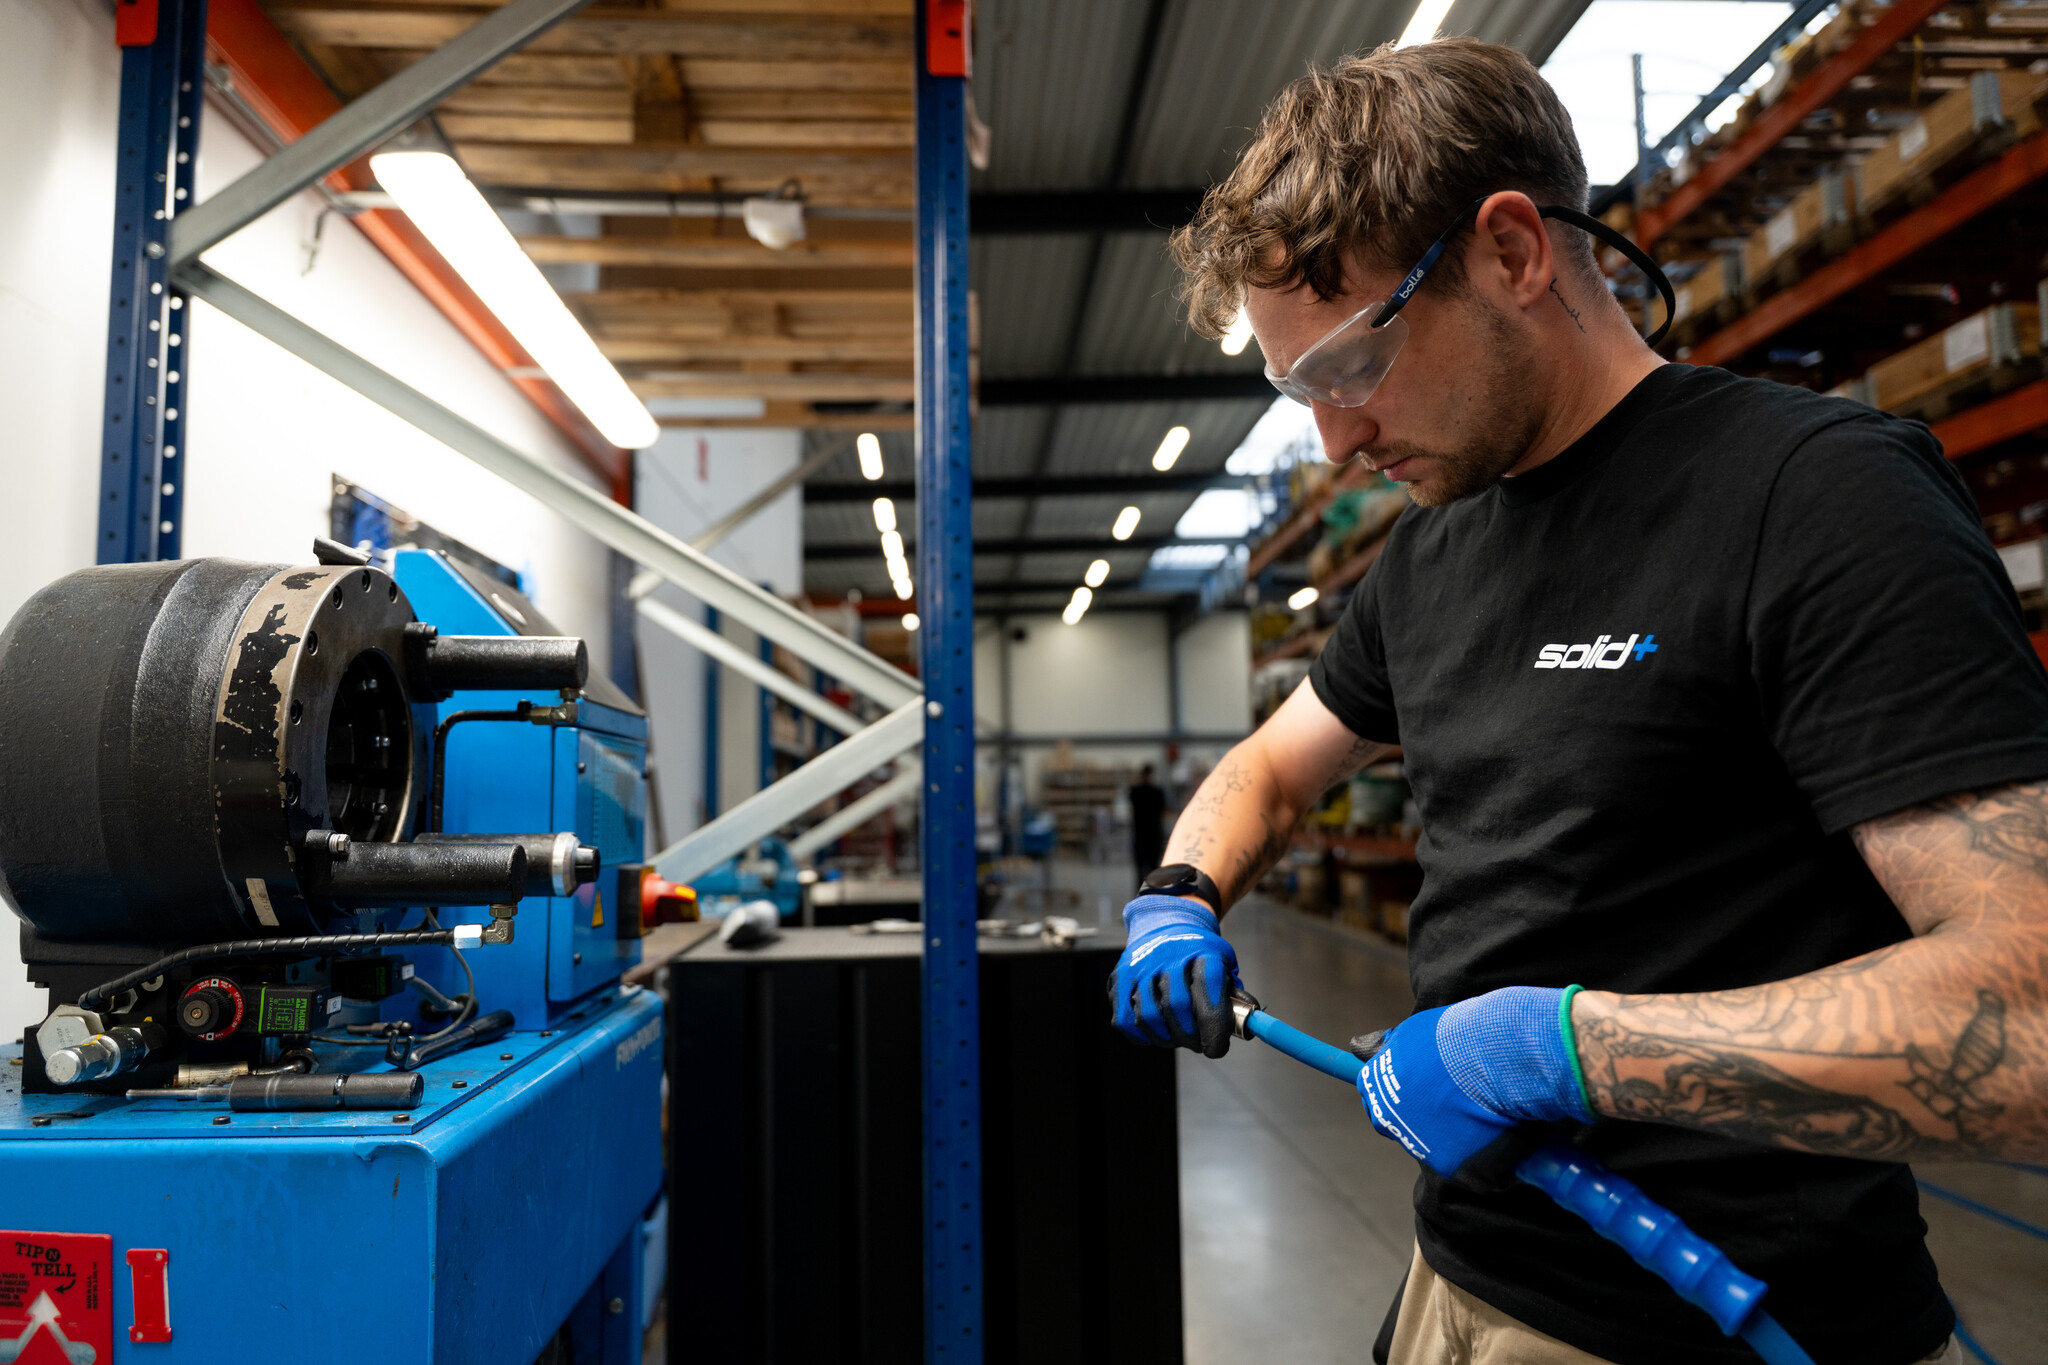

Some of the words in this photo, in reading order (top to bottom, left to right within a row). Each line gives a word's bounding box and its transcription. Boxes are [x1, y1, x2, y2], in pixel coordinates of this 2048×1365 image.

[1399, 268, 1425, 299] bollé
[298, 1009, 306, 1031] MURR
[15, 1242, 44, 1259] TIP
[31, 1262, 76, 1277] TELL
